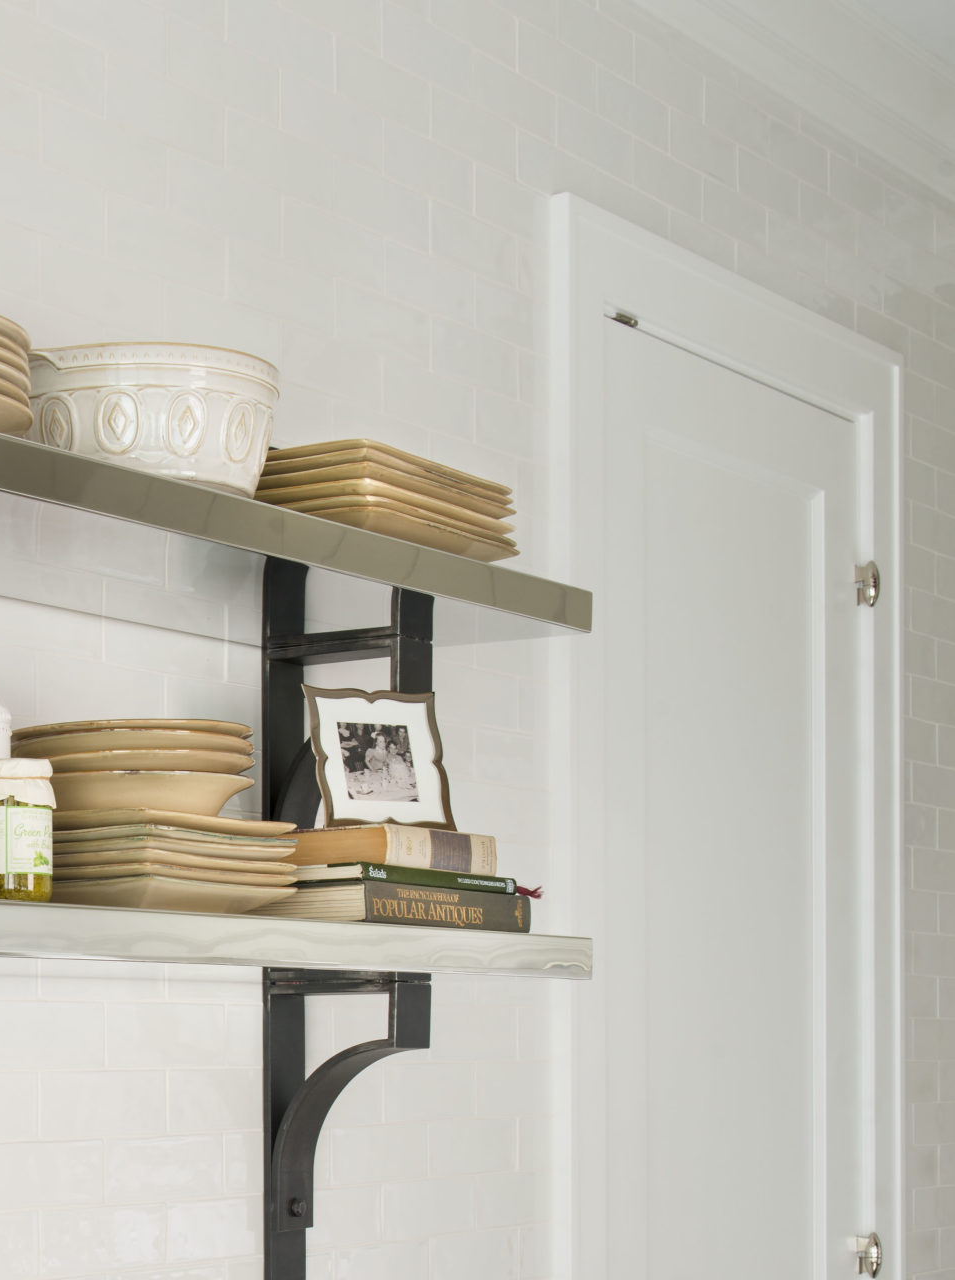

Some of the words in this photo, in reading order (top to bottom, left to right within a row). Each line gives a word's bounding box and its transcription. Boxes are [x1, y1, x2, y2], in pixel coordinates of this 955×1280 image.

[12, 822, 41, 841] Green
[397, 888, 409, 898] THE
[372, 897, 426, 921] POPULAR
[428, 901, 483, 926] ANTIQUES
